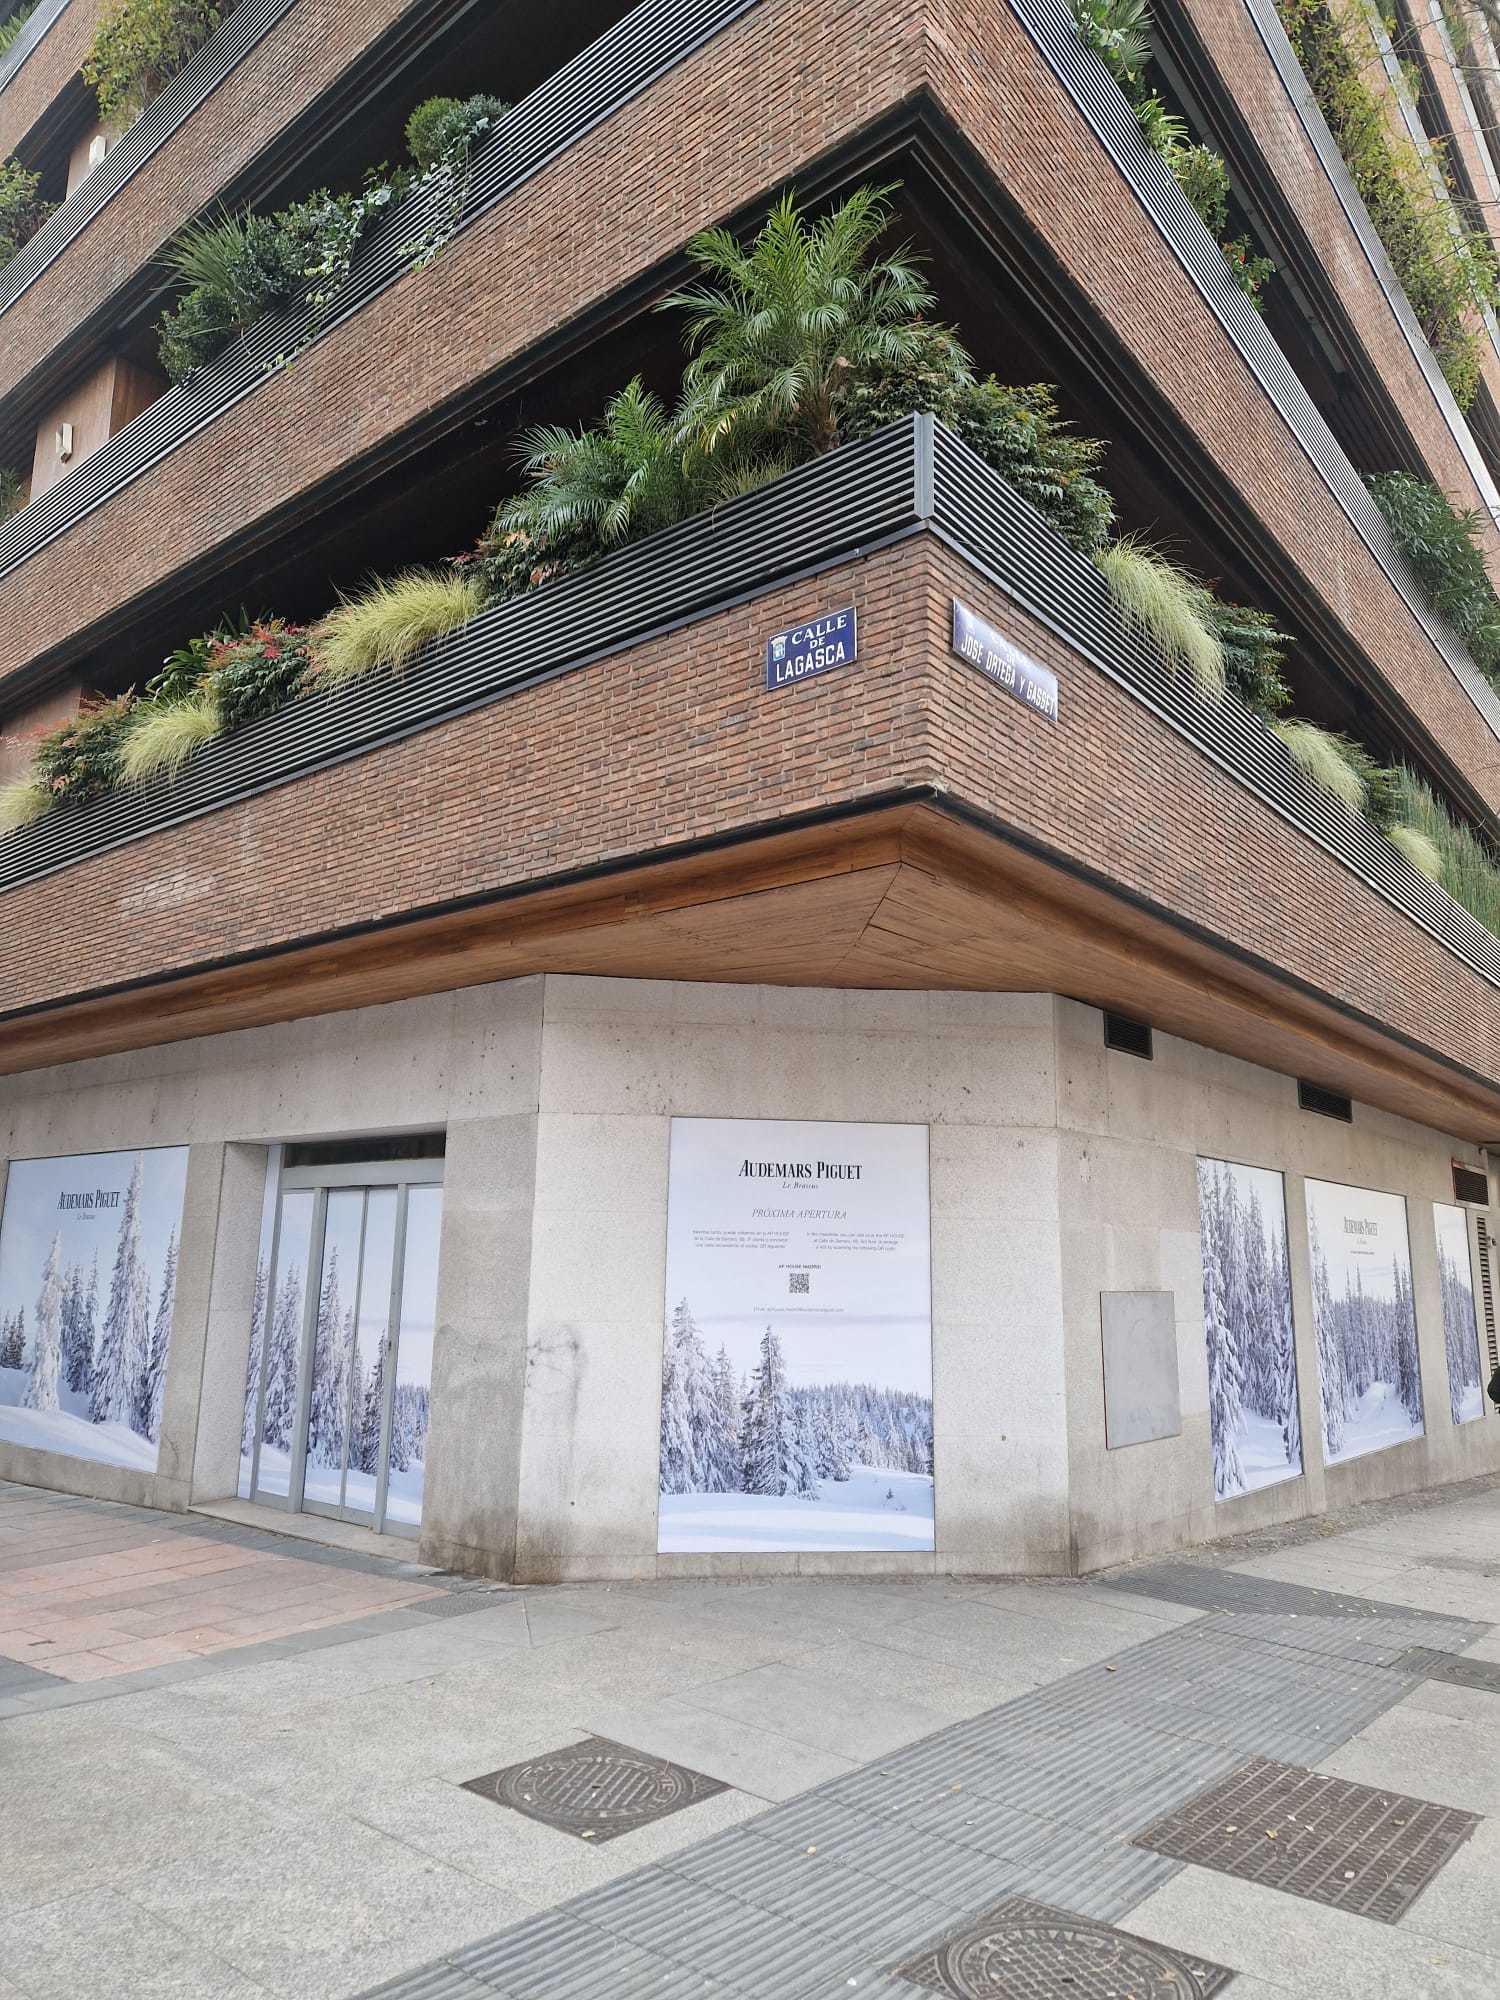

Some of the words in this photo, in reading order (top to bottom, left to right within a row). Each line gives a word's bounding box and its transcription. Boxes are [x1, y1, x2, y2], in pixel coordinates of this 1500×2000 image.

[791, 615, 847, 645] CALLE
[809, 636, 826, 649] DE
[776, 641, 845, 683] LAGASCA
[986, 651, 1016, 688] ORTEGA
[1019, 674, 1026, 694] Y
[1026, 680, 1056, 716] GASSET
[738, 1159, 812, 1179] AUDEMARS
[816, 1161, 863, 1180] PIGUET
[797, 1209, 848, 1220] APERTURA
